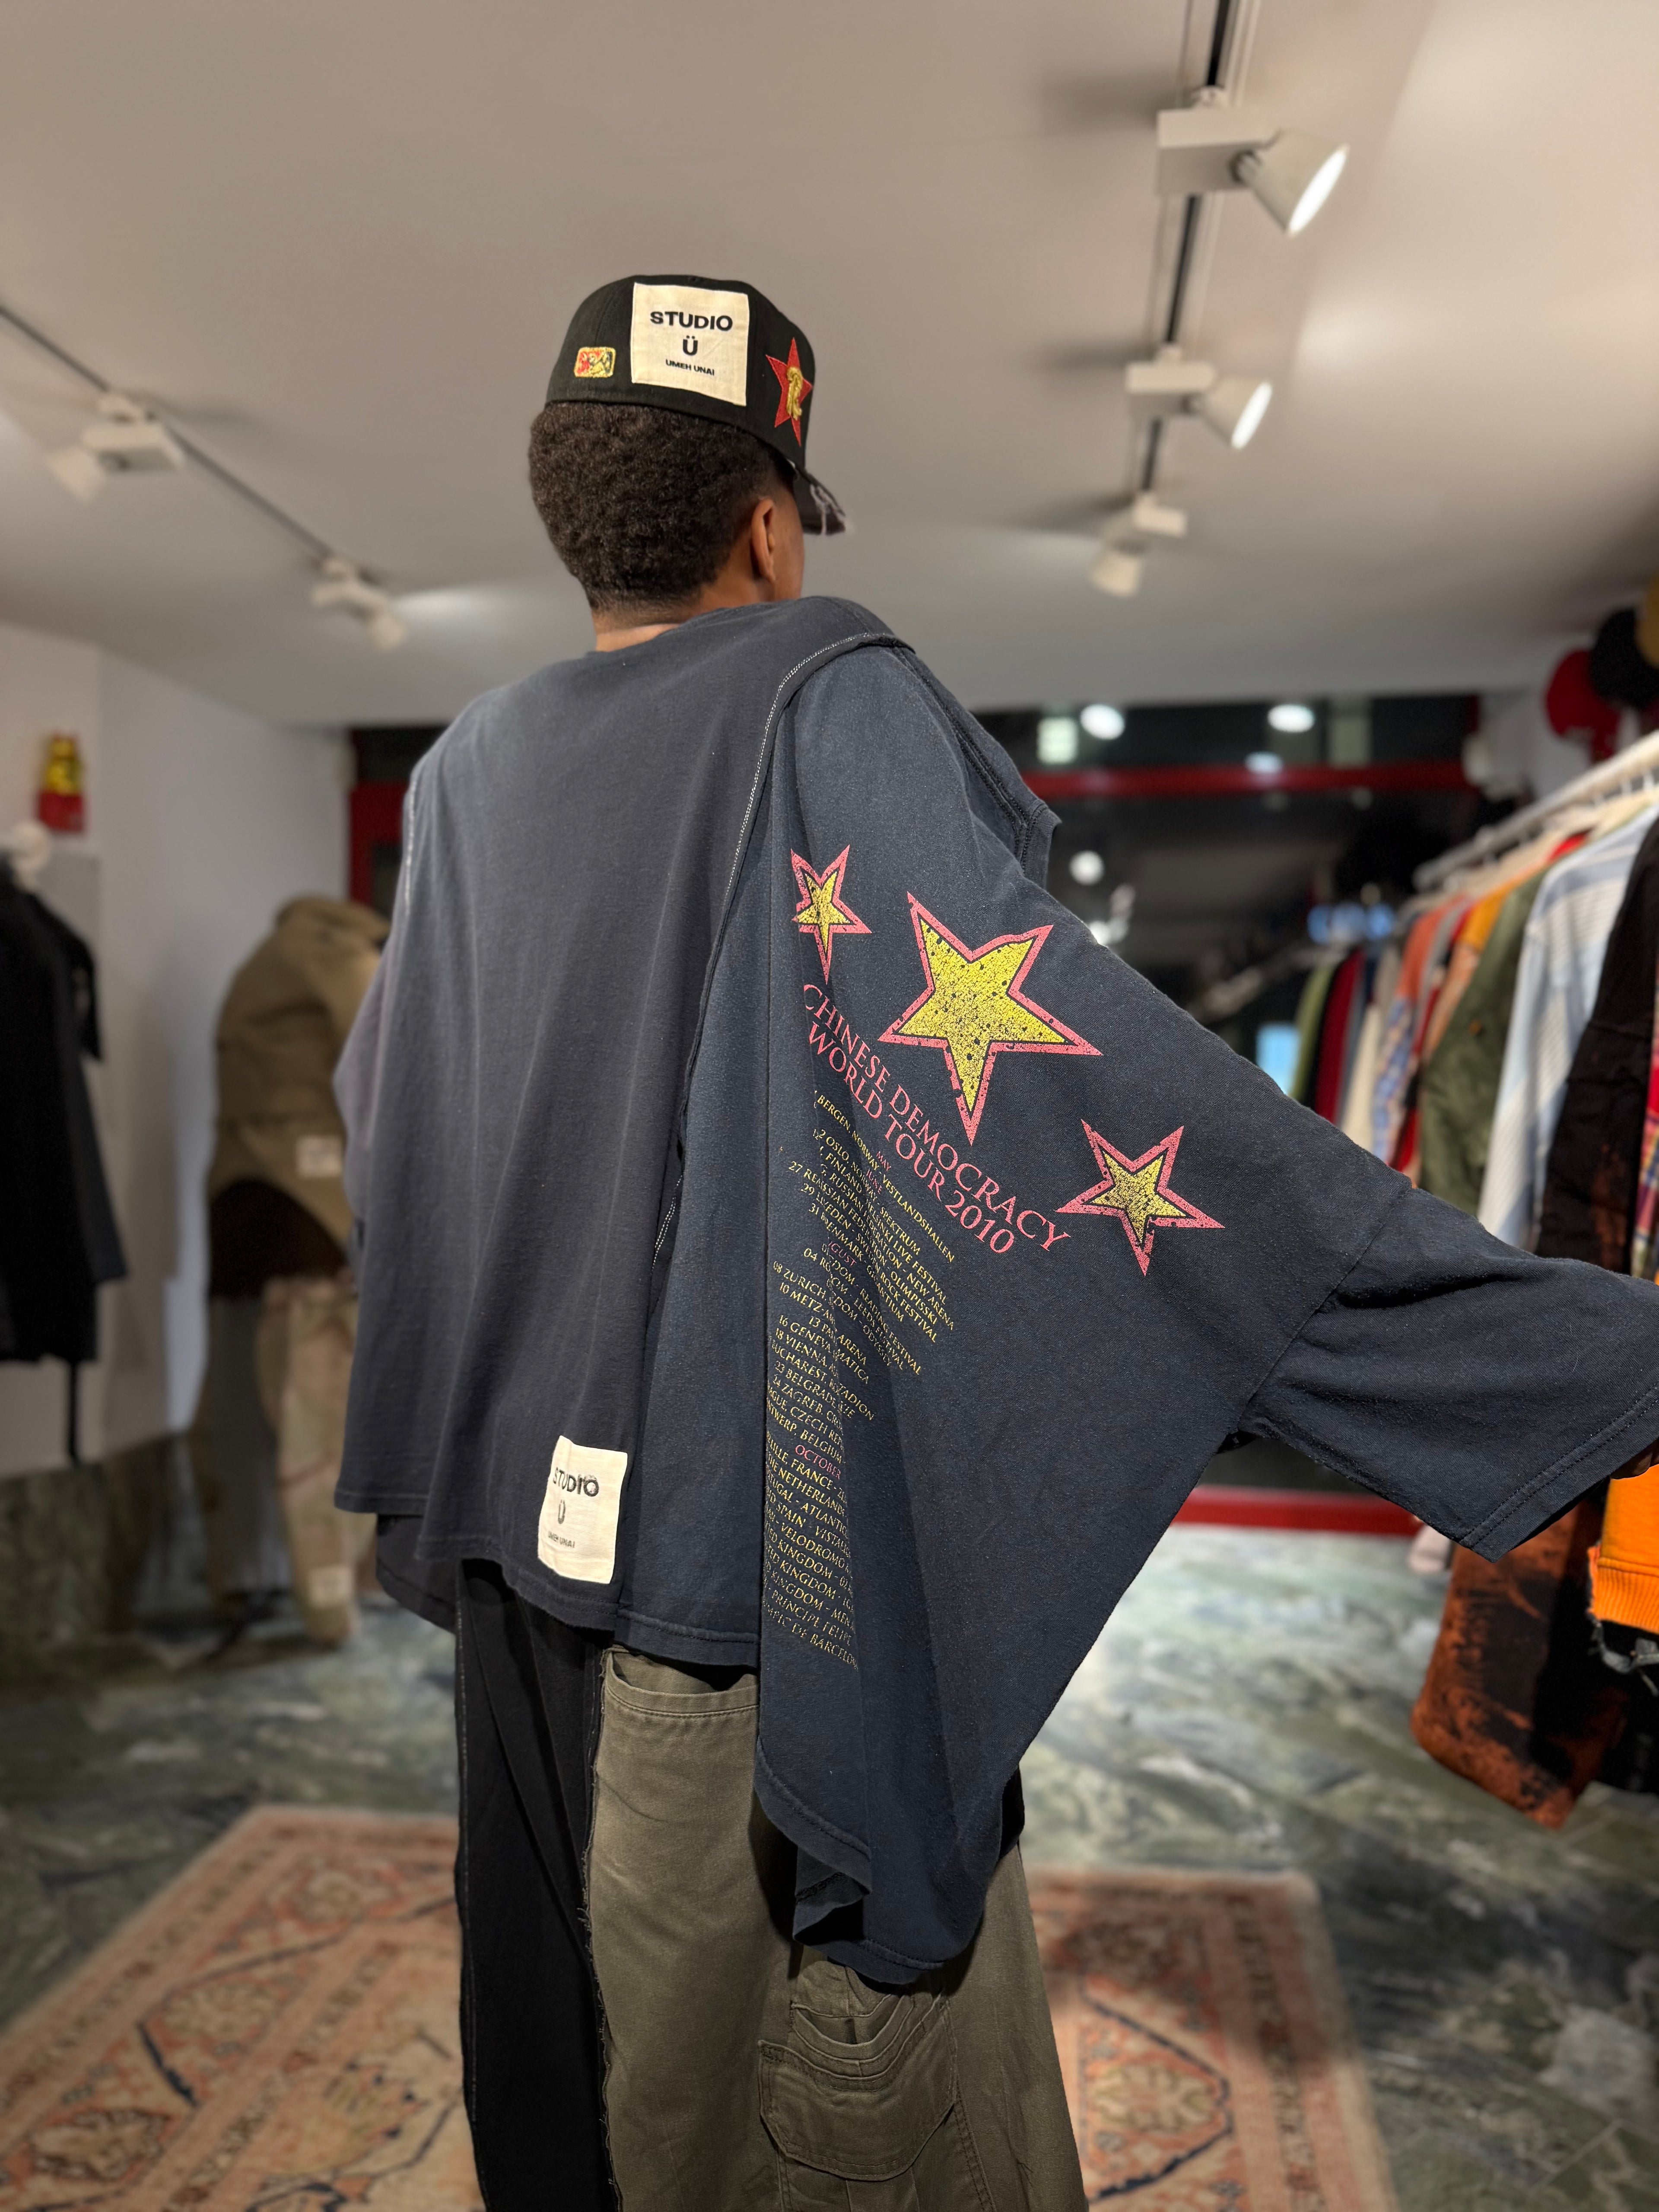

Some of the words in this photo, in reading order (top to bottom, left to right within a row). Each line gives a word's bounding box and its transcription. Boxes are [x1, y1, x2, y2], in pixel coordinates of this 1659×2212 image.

[650, 311, 733, 331] STUDIO
[682, 335, 699, 356] Ü
[665, 359, 691, 372] UMEH
[693, 365, 715, 376] UNAI
[803, 984, 891, 1093] CHINESE
[889, 1084, 1071, 1252] DEMOCRACY
[809, 1021, 883, 1119] WORLD
[884, 1113, 946, 1201] TOUR
[944, 1190, 1014, 1254] 2010
[876, 1151, 891, 1171] MAY
[808, 1202, 820, 1216] 31
[852, 1130, 880, 1170] NORWAY
[882, 1174, 955, 1262] VESTLANDSHALLEN
[788, 1161, 804, 1173] 27
[890, 1271, 938, 1325] OLIMPISSKI
[825, 1152, 862, 1193] FINLAND
[893, 1240, 913, 1264] LIVE
[912, 1261, 947, 1305] FESTIVAL
[880, 1206, 921, 1255] SPEKTRUM
[772, 1260, 783, 1274] 08
[800, 1182, 815, 1195] 29
[880, 1271, 901, 1301] ROCK
[900, 1299, 937, 1343] FESTIVAL
[803, 1247, 818, 1261] 04
[829, 1173, 864, 1212] RUSSIAN
[906, 1272, 930, 1297] NEW
[928, 1296, 954, 1331] ARENA
[779, 1281, 790, 1294] 10
[775, 1327, 784, 1340] 18
[779, 1314, 788, 1327] 16
[808, 1316, 821, 1328] 13
[837, 1334, 867, 1366] ARENA
[889, 1332, 922, 1376] FESTIVAL
[790, 1406, 828, 1435] CZECH
[795, 1444, 842, 1481] OCTOBER
[800, 1429, 842, 1464] BELGIUM
[553, 1467, 599, 1497] STUDIO
[791, 1459, 833, 1491] FRANCE
[776, 1502, 806, 1528] SPAIN
[559, 1536, 575, 1548] UNAI
[778, 1539, 833, 1579] KINGDOM
[781, 1522, 845, 1569] VELODROMO
[771, 1570, 824, 1611] KINGDOM
[780, 1560, 836, 1600] KINGDOM
[771, 1589, 820, 1628] PRINCIPE
